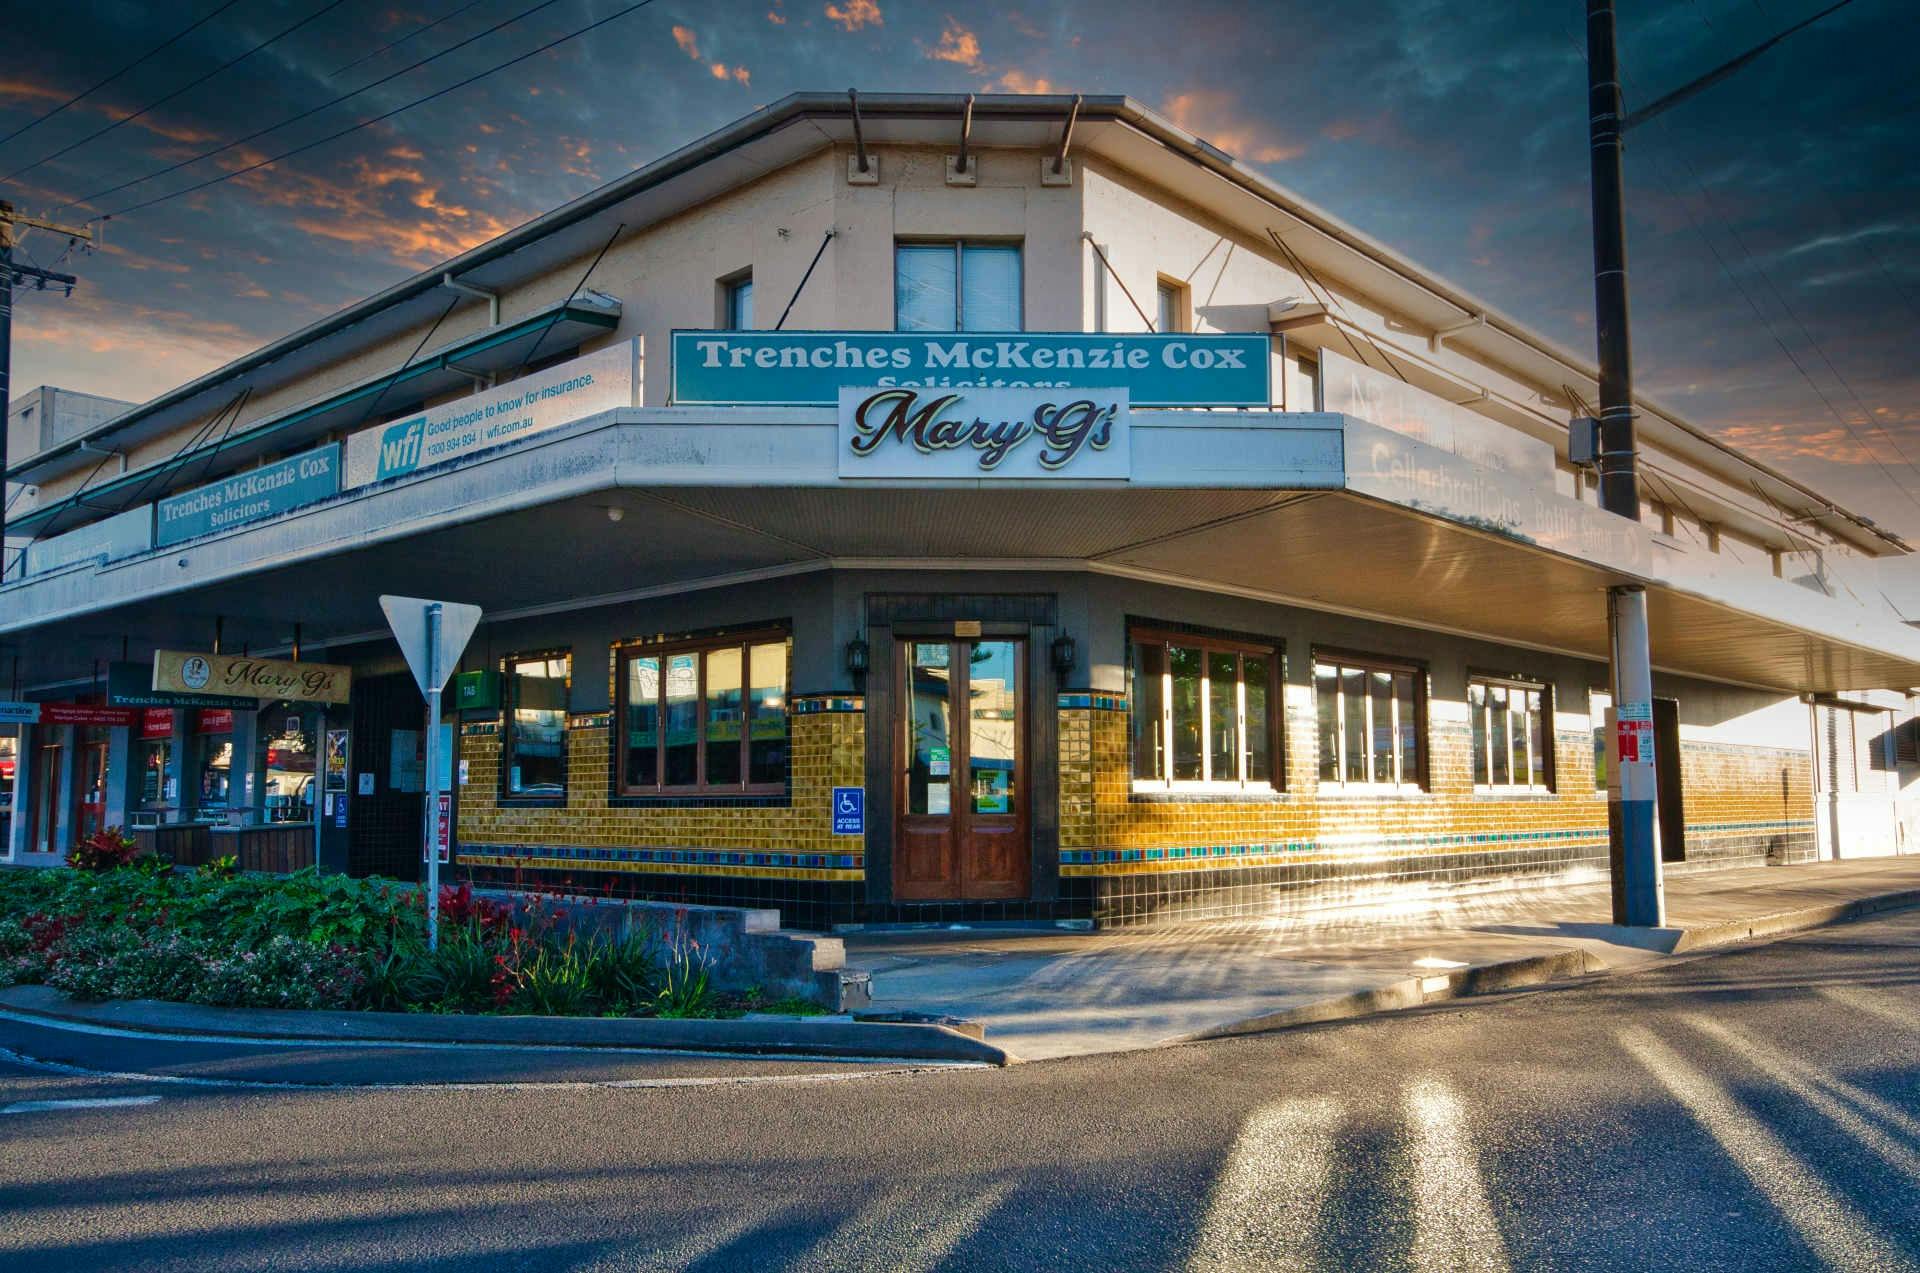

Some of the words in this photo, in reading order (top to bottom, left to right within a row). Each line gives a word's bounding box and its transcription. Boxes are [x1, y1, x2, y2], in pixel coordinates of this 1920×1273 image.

[697, 341, 912, 369] Trenches
[924, 341, 1151, 369] McKenzie
[1162, 342, 1247, 370] Cox
[428, 422, 450, 436] Good
[453, 408, 483, 428] people
[485, 405, 495, 418] to
[496, 396, 523, 414] know
[525, 390, 539, 405] for
[541, 373, 595, 400] insurance.
[384, 422, 421, 471] wfi
[428, 442, 446, 457] 1300
[447, 439, 461, 451] 934
[462, 432, 477, 446] 934
[486, 416, 533, 439] wfi.com.au
[851, 389, 1034, 470] Mary
[1033, 400, 1118, 470] G's
[164, 492, 222, 522] Trenches
[225, 468, 296, 500] McKenzie
[299, 456, 330, 479] Cox
[210, 500, 270, 527] Solicitors
[224, 660, 297, 695] Mary
[301, 670, 334, 697] G's
[113, 696, 171, 705] Trenches
